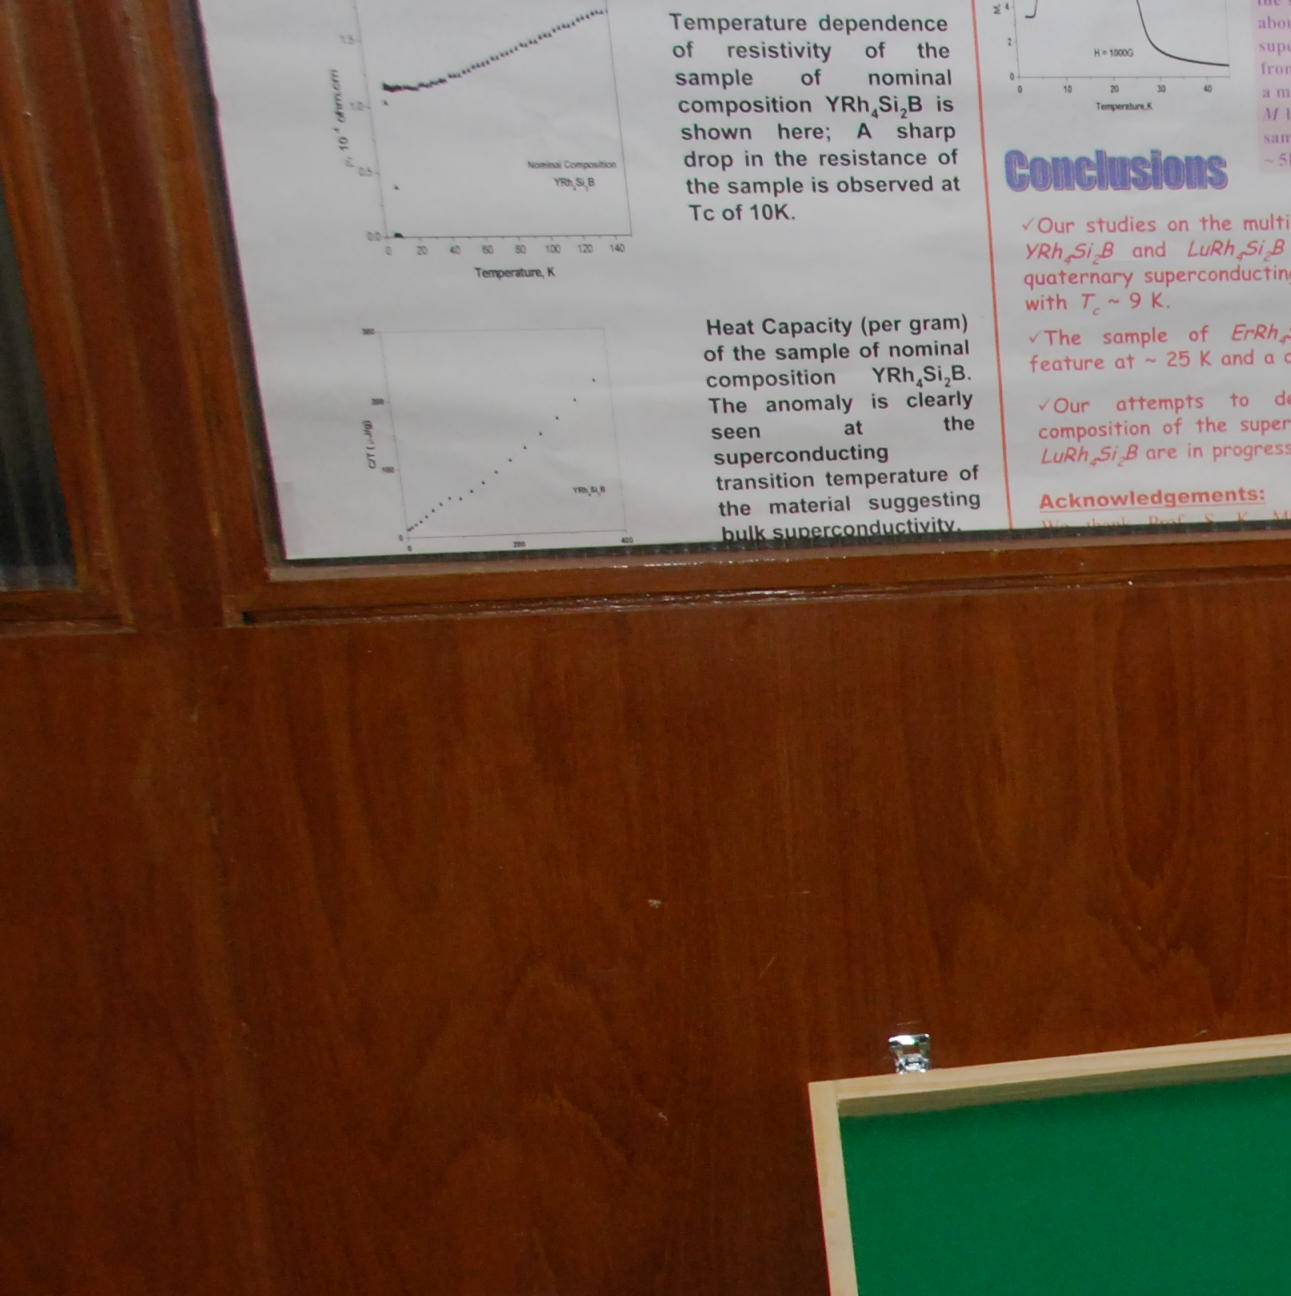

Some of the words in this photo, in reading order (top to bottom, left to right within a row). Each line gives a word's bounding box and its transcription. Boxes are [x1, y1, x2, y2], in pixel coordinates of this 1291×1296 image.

[669, 12, 807, 34] Temperature
[819, 15, 948, 34] dependence
[672, 41, 693, 59] of
[727, 42, 831, 62] resistivity
[865, 42, 886, 58] of
[917, 42, 950, 58] the
[675, 69, 753, 89] sample
[800, 69, 821, 86] of
[868, 69, 952, 86] nominal
[678, 96, 812, 117] composition
[936, 96, 954, 112] is
[680, 124, 752, 140] shown
[777, 123, 831, 142] here;
[857, 123, 872, 139] A
[896, 122, 956, 142] sharp
[528, 160, 562, 170] Nominal
[563, 160, 617, 171] Composition
[683, 151, 733, 171] drop
[745, 151, 763, 167] in
[774, 150, 808, 166] the
[819, 150, 927, 166] resistance
[938, 149, 958, 165] of
[1003, 148, 1230, 193] Conclusions
[686, 178, 720, 194] the
[727, 177, 804, 197] sample
[812, 177, 829, 193] is
[836, 176, 933, 193] observed
[941, 177, 960, 192] at
[689, 205, 715, 221] Tc
[722, 204, 743, 221] of
[750, 204, 796, 220] 10K.
[1038, 218, 1075, 234] Our
[1086, 217, 1157, 234] studies
[1167, 220, 1190, 233] on
[1199, 215, 1233, 232] the
[1132, 242, 1167, 258] and
[475, 266, 545, 279] Temperature,
[547, 266, 556, 277] K
[1024, 270, 1133, 290] quaternary
[706, 319, 755, 335] Heat
[762, 317, 852, 338] Capacity
[861, 316, 902, 337] (per
[909, 314, 968, 335] gram)
[1044, 330, 1081, 345] The
[1103, 328, 1168, 348] sample
[1188, 326, 1209, 343] of
[704, 345, 724, 362] of
[733, 345, 766, 361] the
[775, 342, 850, 363] sample
[859, 341, 880, 358] of
[889, 340, 970, 357] nominal
[706, 370, 836, 390] composition
[709, 398, 748, 414] The
[766, 395, 853, 414] anomaly
[871, 393, 889, 409] is
[906, 391, 973, 410] clearly
[1053, 398, 1090, 414] Our
[1116, 395, 1204, 414] attempts
[1230, 394, 1249, 408] to
[711, 424, 761, 440] seen
[844, 421, 863, 435] at
[943, 416, 975, 432] the
[714, 445, 889, 468] superconducting
[716, 473, 815, 491] transition
[825, 467, 948, 488] temperature
[959, 464, 979, 480] of
[718, 501, 751, 517] the
[769, 497, 851, 515] material
[868, 491, 981, 513] suggesting
[1039, 487, 1266, 511] Acknowledgements:
[722, 526, 766, 542] bulk
[772, 518, 962, 539] superconductivity.
